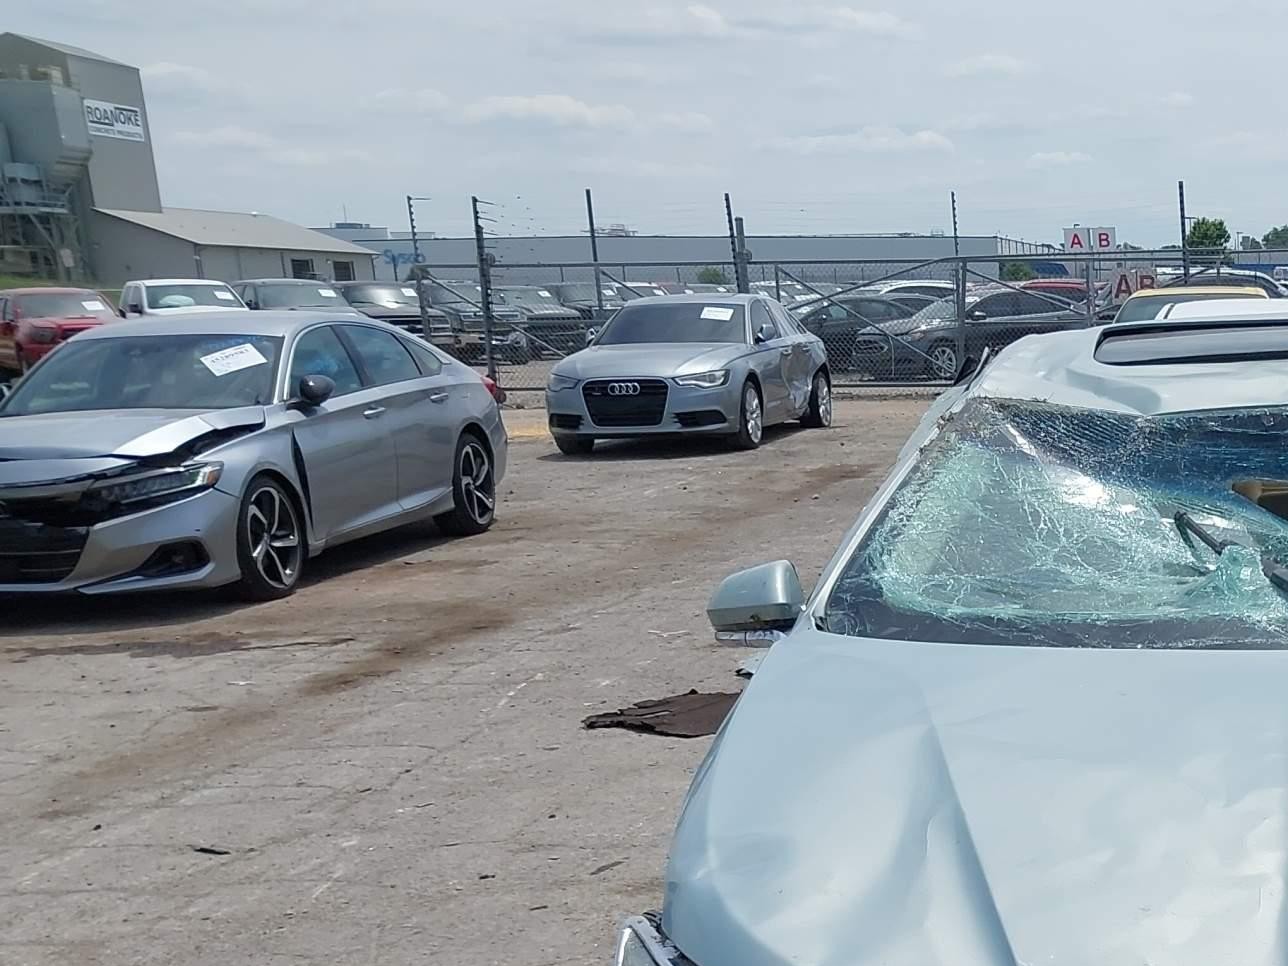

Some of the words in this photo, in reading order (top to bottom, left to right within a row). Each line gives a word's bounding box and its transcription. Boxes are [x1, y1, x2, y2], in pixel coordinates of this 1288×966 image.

[86, 104, 141, 127] ROANOKE
[1070, 233, 1084, 248] A
[1098, 232, 1110, 248] B
[1114, 274, 1132, 299] A
